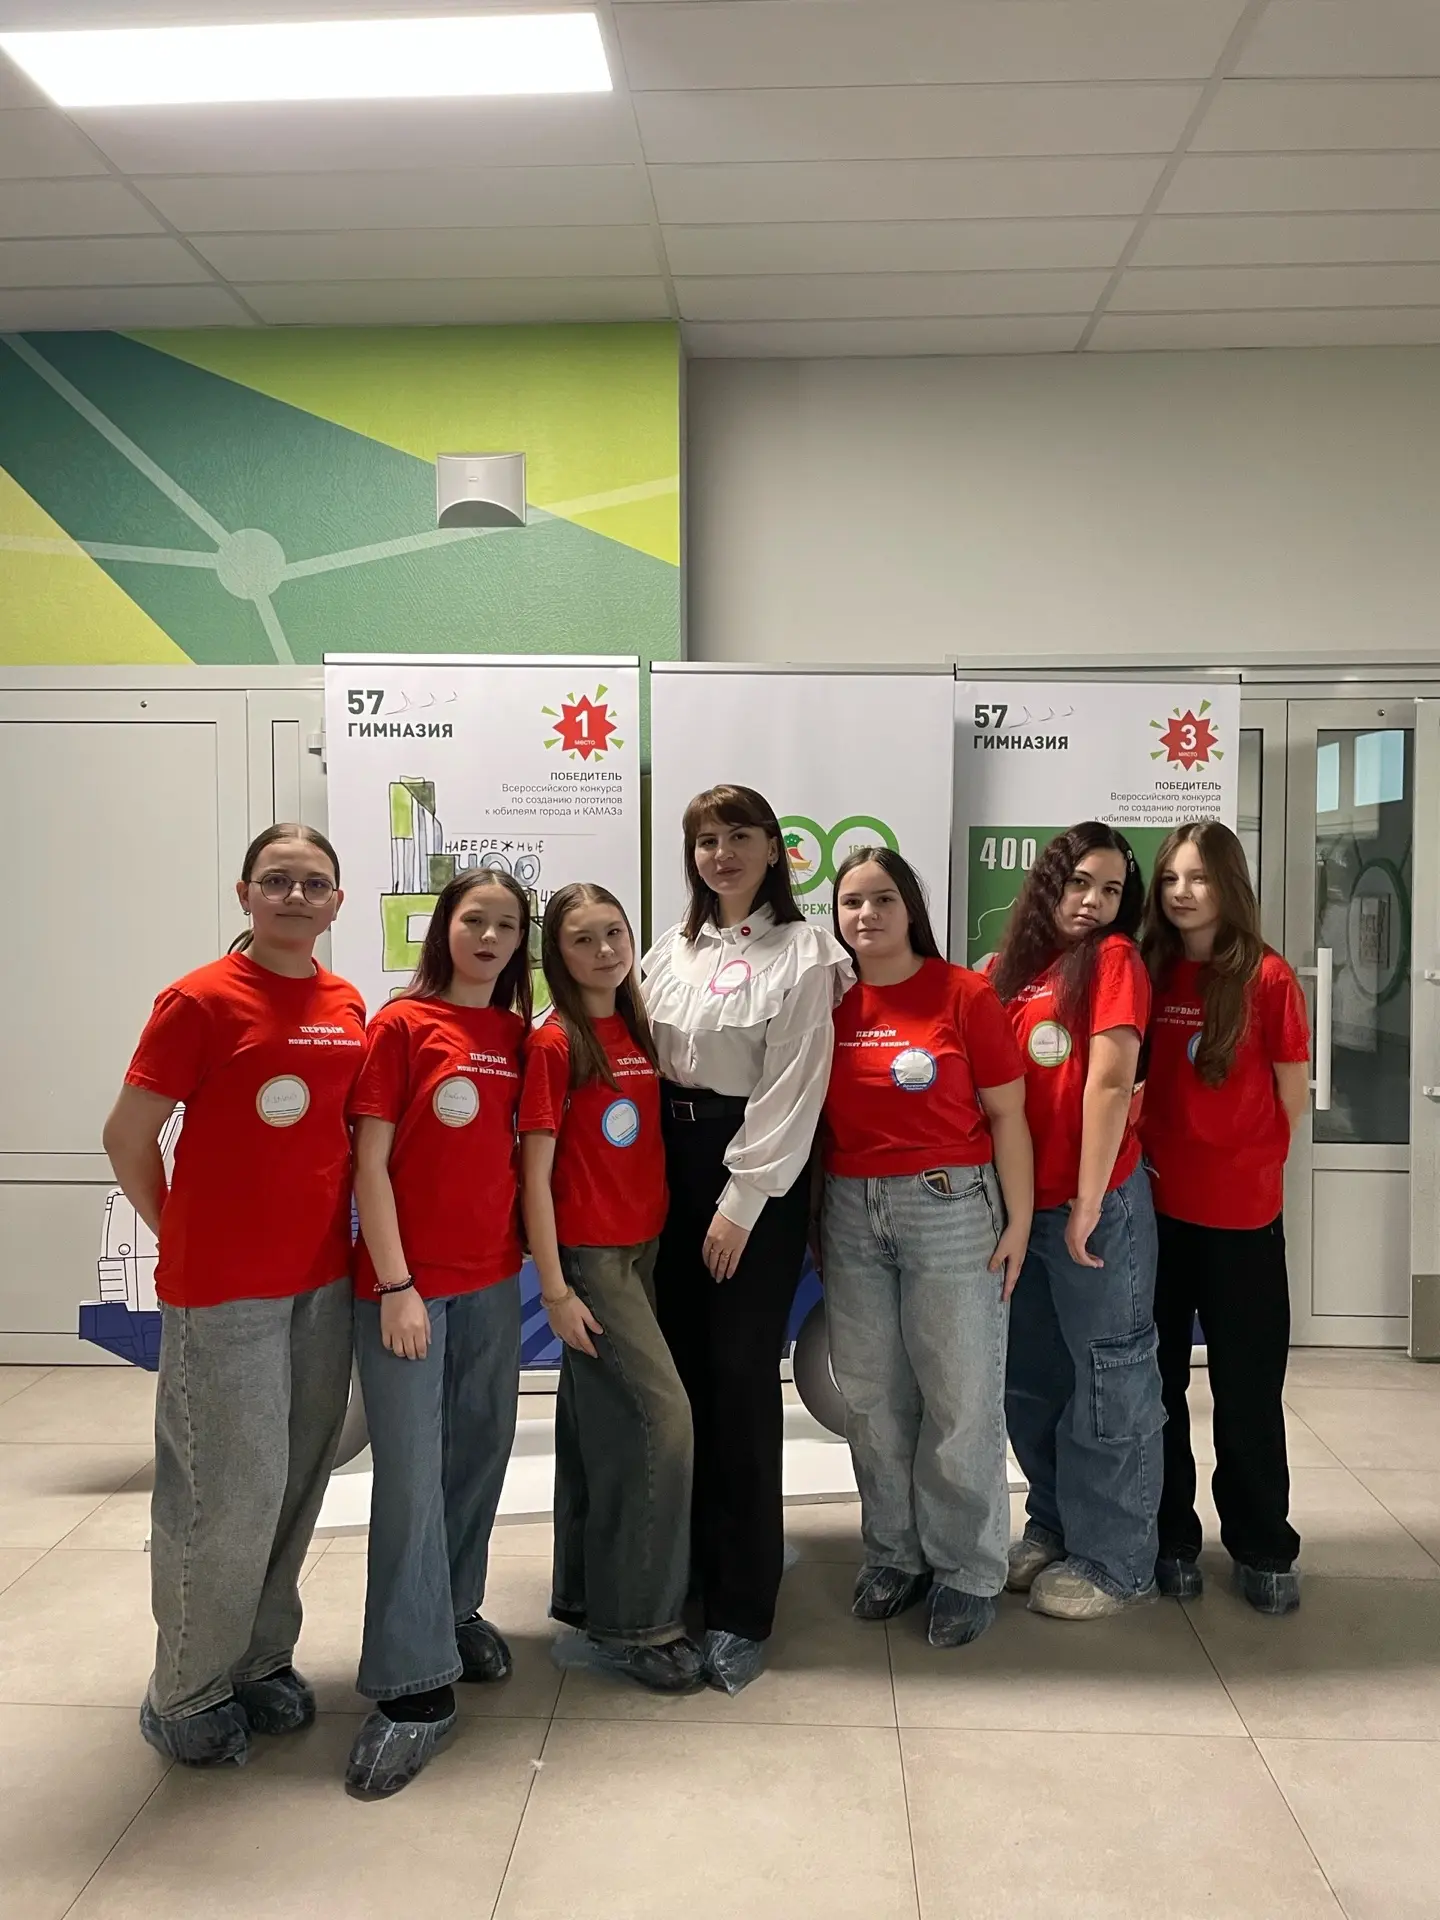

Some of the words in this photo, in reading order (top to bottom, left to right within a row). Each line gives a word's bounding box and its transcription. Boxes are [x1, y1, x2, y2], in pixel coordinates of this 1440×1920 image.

[347, 690, 384, 715] 57
[974, 704, 1008, 729] 57
[575, 710, 588, 738] 1
[348, 723, 453, 738] ГИМНАЗИЯ
[974, 735, 1068, 750] ГИМНАЗИЯ
[1180, 724, 1197, 750] 3
[550, 772, 622, 782] ПОБЕДИТЕЛЬ
[502, 783, 578, 793] Всероссийского
[580, 785, 623, 794] конкурса
[1155, 781, 1221, 791] ПОБЕДИТЕЛЬ
[511, 796, 523, 804] по
[525, 796, 573, 805] созданию
[574, 796, 623, 804] логотипов
[1110, 792, 1180, 802] Всероссийского
[1182, 794, 1221, 803] конкурса
[492, 807, 537, 816] юбилеям
[539, 808, 572, 817] города
[582, 807, 623, 816] КАМАЗа
[1118, 804, 1130, 812] по
[1131, 804, 1174, 813] созданию
[1176, 804, 1221, 812] логотипов
[1101, 814, 1141, 823] юбилеям
[1143, 815, 1173, 824] города
[445, 839, 544, 853] НАБЕРЕЖНЫЕ
[979, 837, 1036, 870] 400
[299, 1026, 345, 1034] ПЕРВЫМ
[856, 1029, 897, 1038] ПЕРВЫМ
[469, 1052, 507, 1065] ПЕРВЫМ
